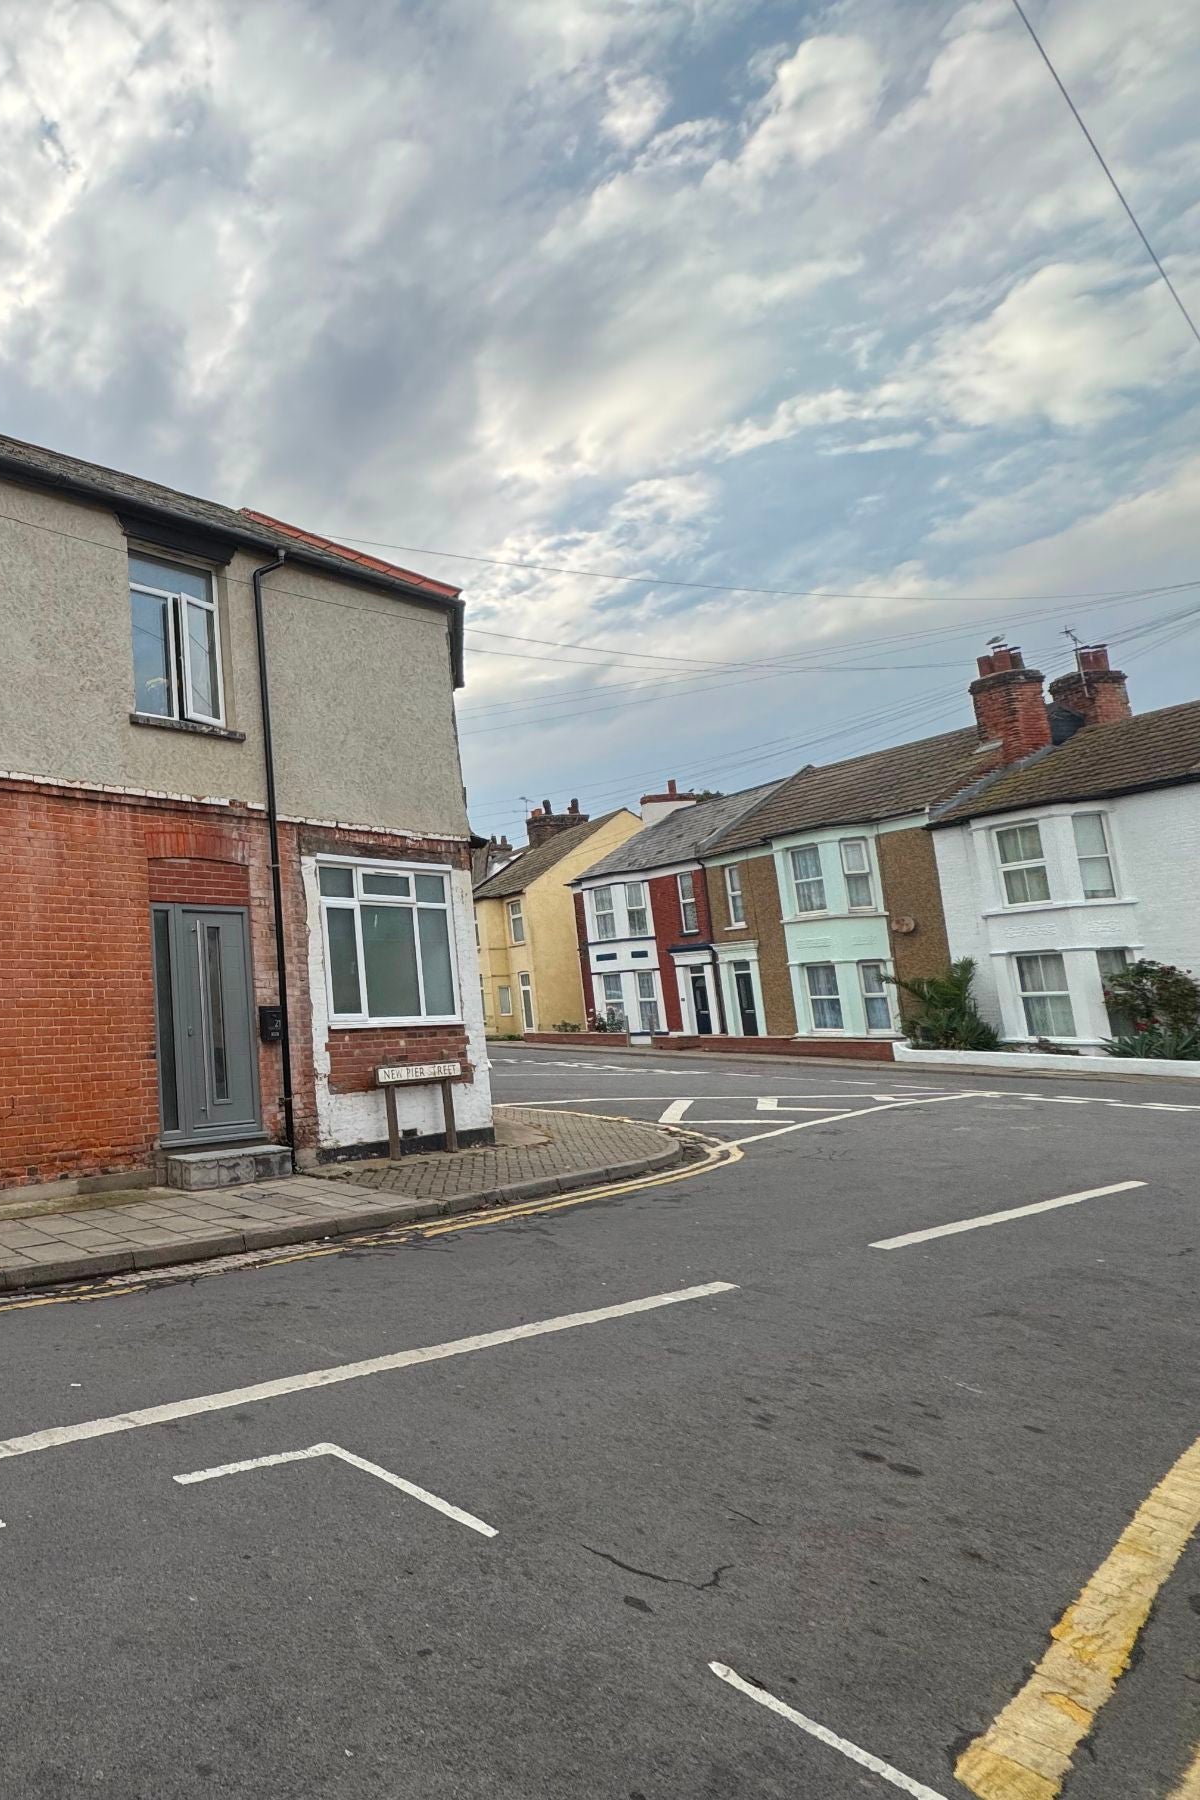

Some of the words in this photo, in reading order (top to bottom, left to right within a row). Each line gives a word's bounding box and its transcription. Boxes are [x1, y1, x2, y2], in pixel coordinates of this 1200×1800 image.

[383, 1069, 402, 1080] NEW
[406, 1067, 425, 1078] PIER
[428, 1064, 456, 1076] STREET
